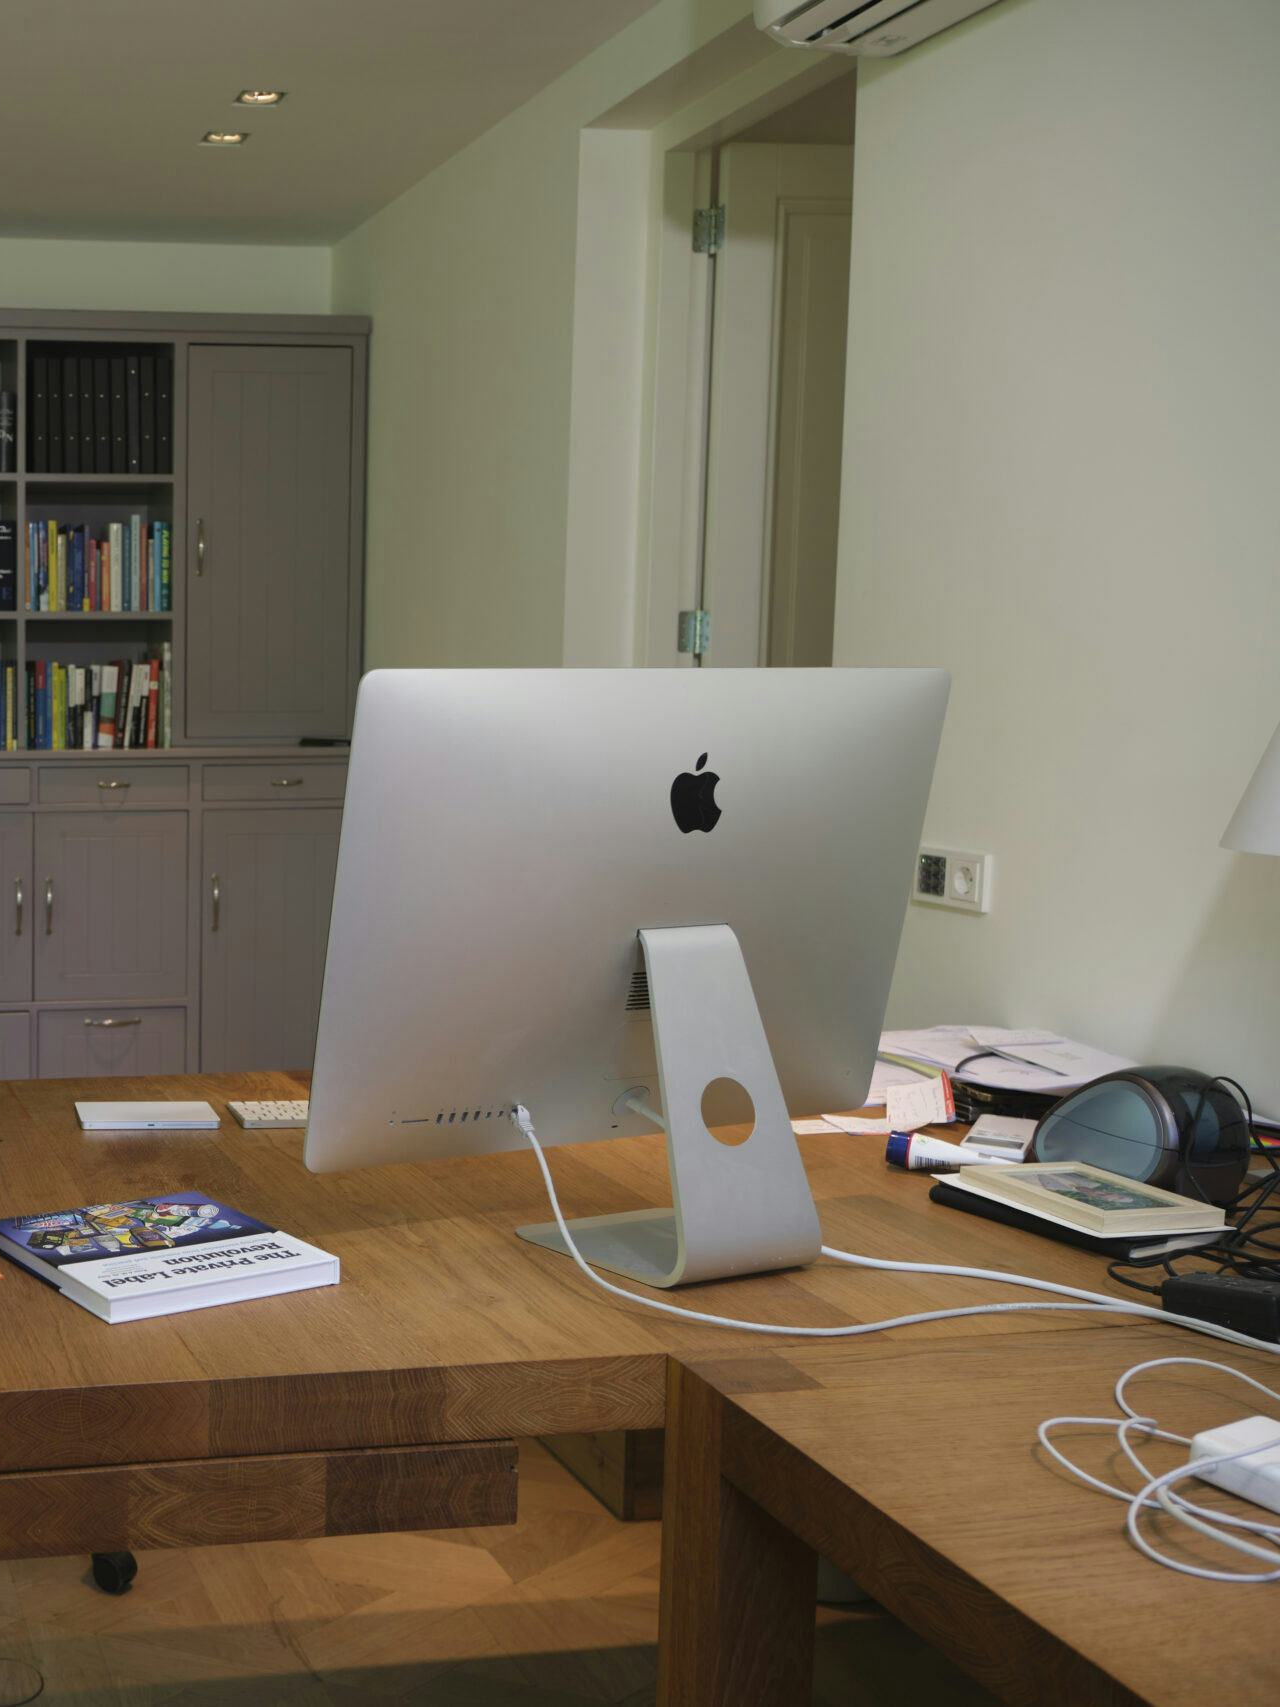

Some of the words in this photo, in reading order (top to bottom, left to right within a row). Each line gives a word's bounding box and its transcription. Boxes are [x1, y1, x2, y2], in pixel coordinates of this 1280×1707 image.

[163, 1242, 281, 1265] Revolution
[255, 1248, 301, 1261] The
[177, 1258, 256, 1275] Private
[103, 1272, 172, 1287] Label
